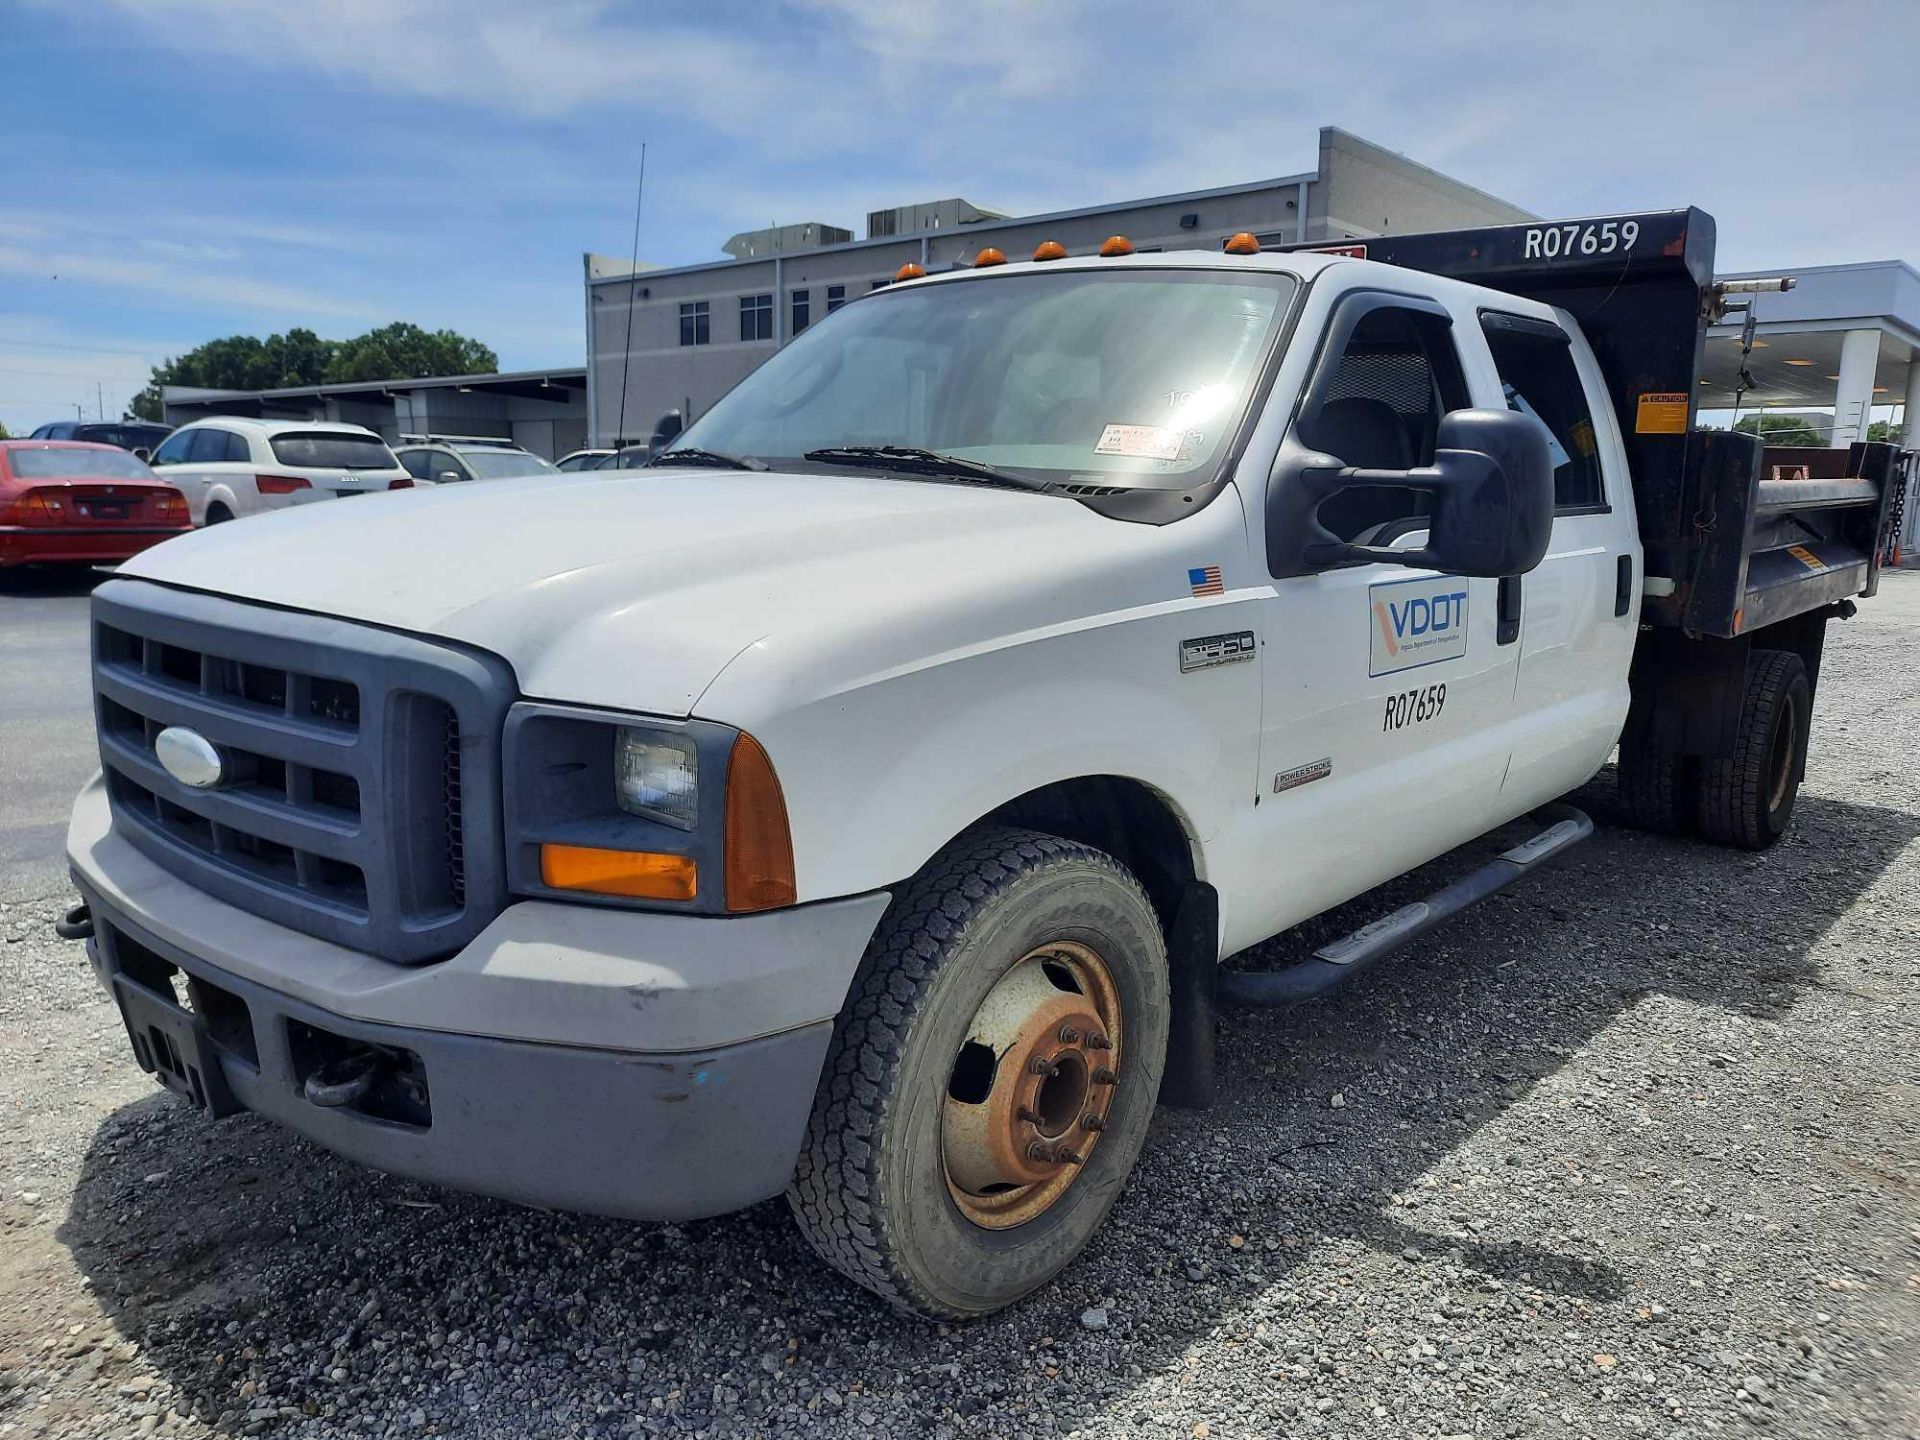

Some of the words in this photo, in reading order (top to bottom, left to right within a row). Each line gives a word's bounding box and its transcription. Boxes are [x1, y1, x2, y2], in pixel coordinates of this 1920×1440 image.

[1524, 221, 1640, 259] R07659
[1389, 591, 1467, 638] VDOT
[1383, 683, 1447, 732] R07659
